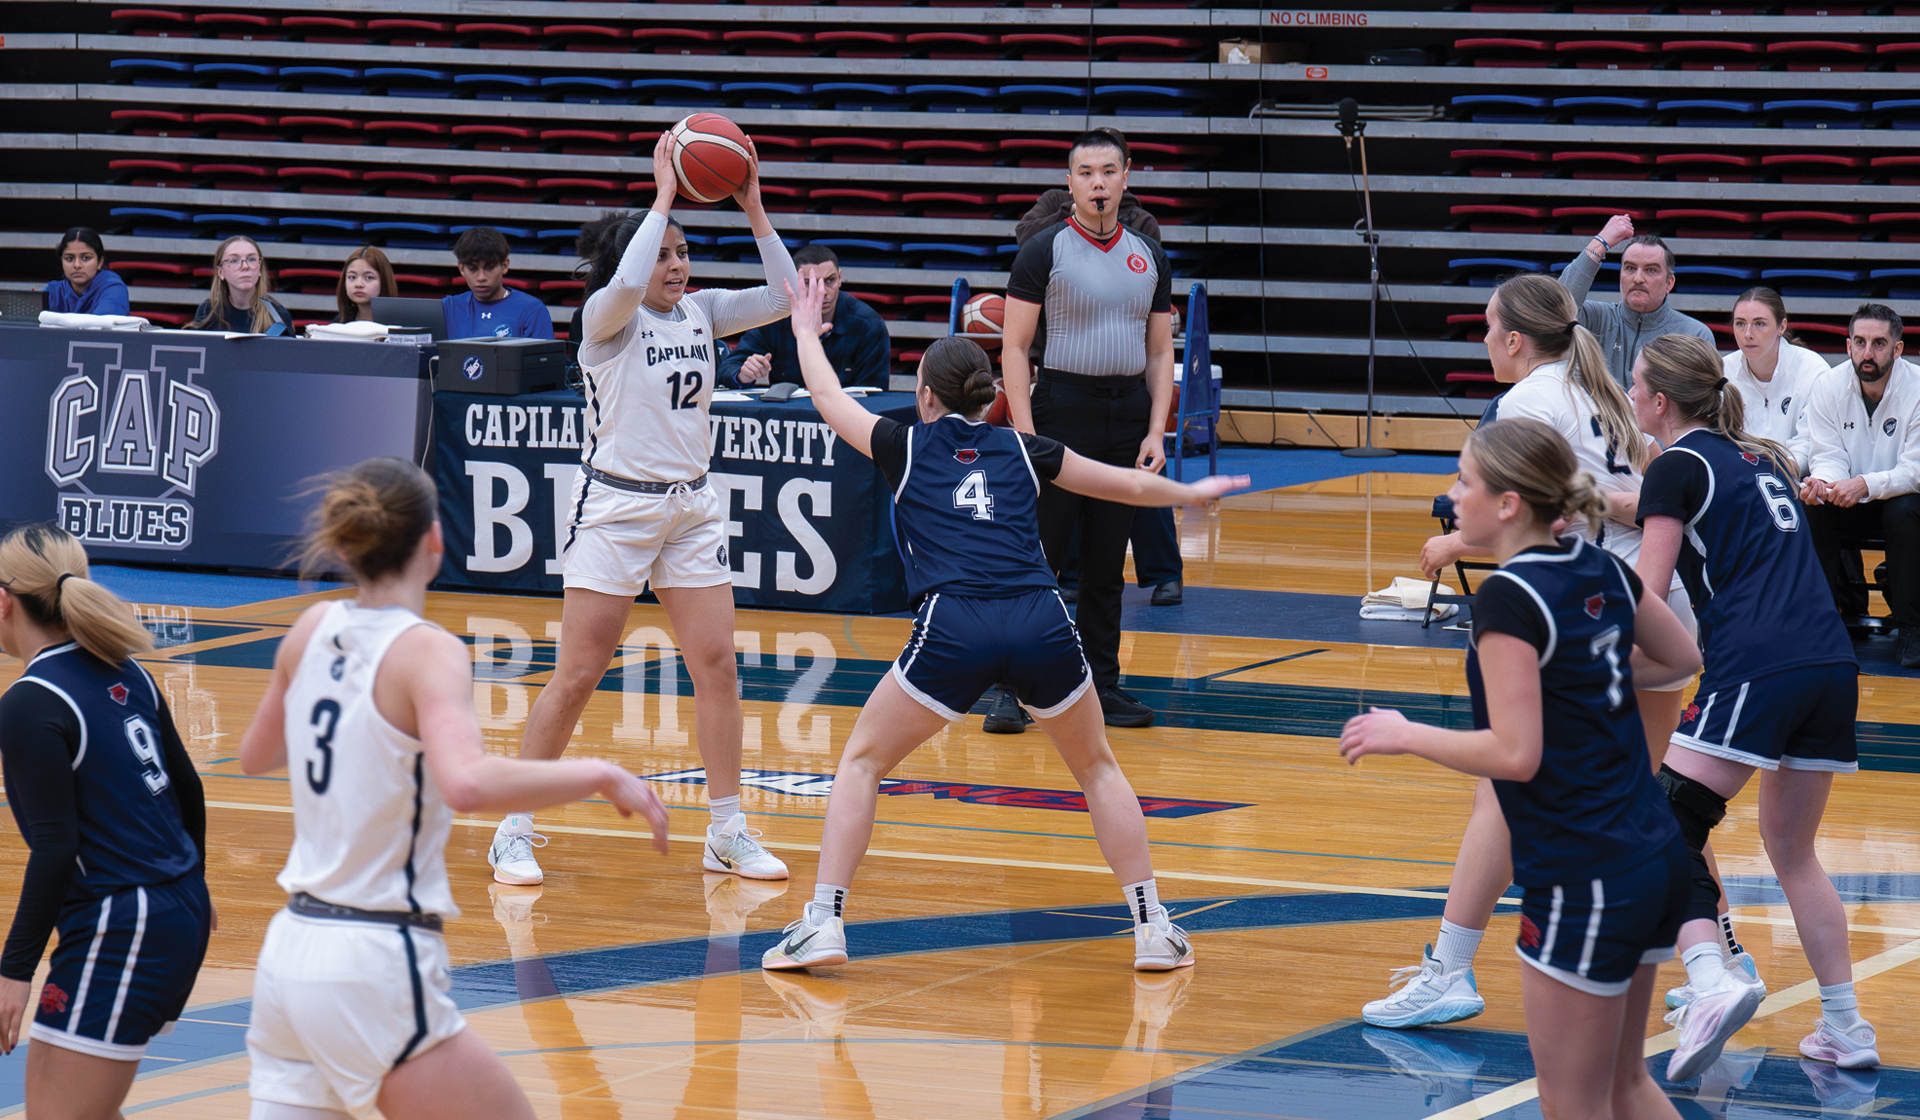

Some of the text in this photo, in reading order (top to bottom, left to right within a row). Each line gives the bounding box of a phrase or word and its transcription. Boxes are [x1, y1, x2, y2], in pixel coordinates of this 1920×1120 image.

[1270, 11, 1368, 26] NO CLIMBING
[666, 370, 703, 411] 12
[47, 371, 219, 493] CAP
[464, 402, 590, 449] CAPILA
[60, 497, 191, 546] BLUES
[952, 469, 995, 522] 4
[1754, 472, 1801, 533] 6
[464, 459, 838, 597] BES
[1589, 624, 1625, 712] 7
[123, 713, 171, 797] 9
[306, 698, 342, 796] 3
